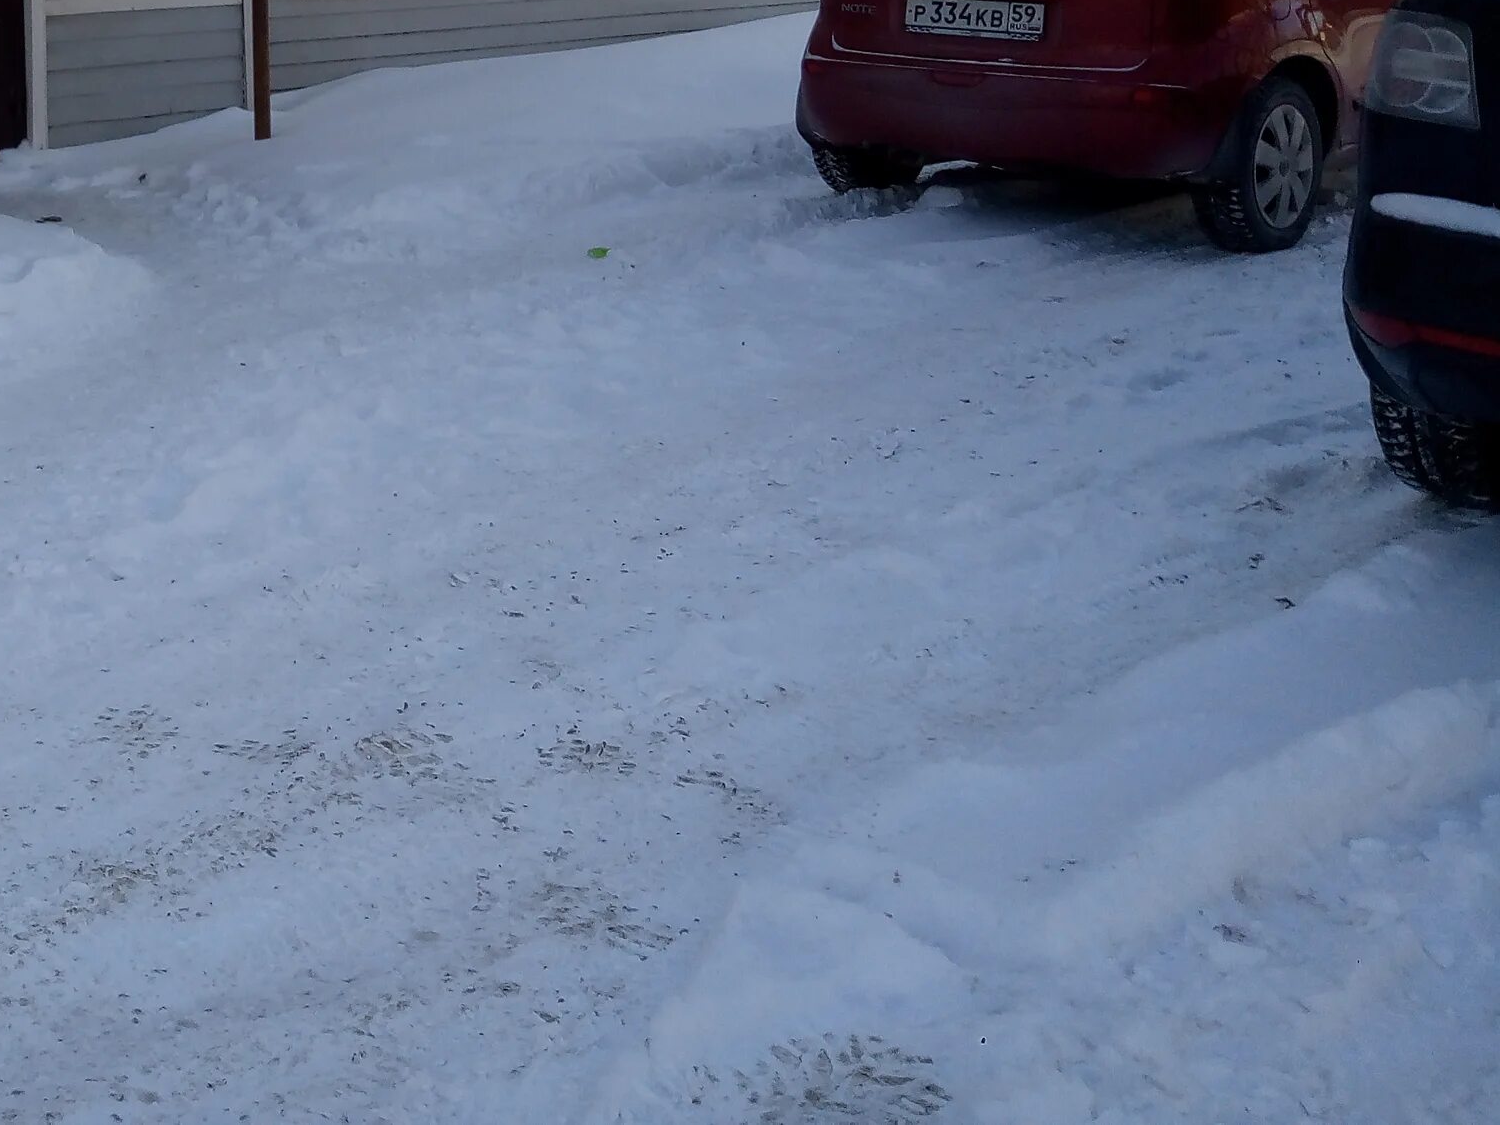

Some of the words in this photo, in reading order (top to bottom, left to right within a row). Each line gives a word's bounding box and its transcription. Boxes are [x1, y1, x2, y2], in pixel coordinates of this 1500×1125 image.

[841, 3, 877, 15] NOTE
[1011, 4, 1037, 23] 59
[1009, 23, 1028, 31] RUS
